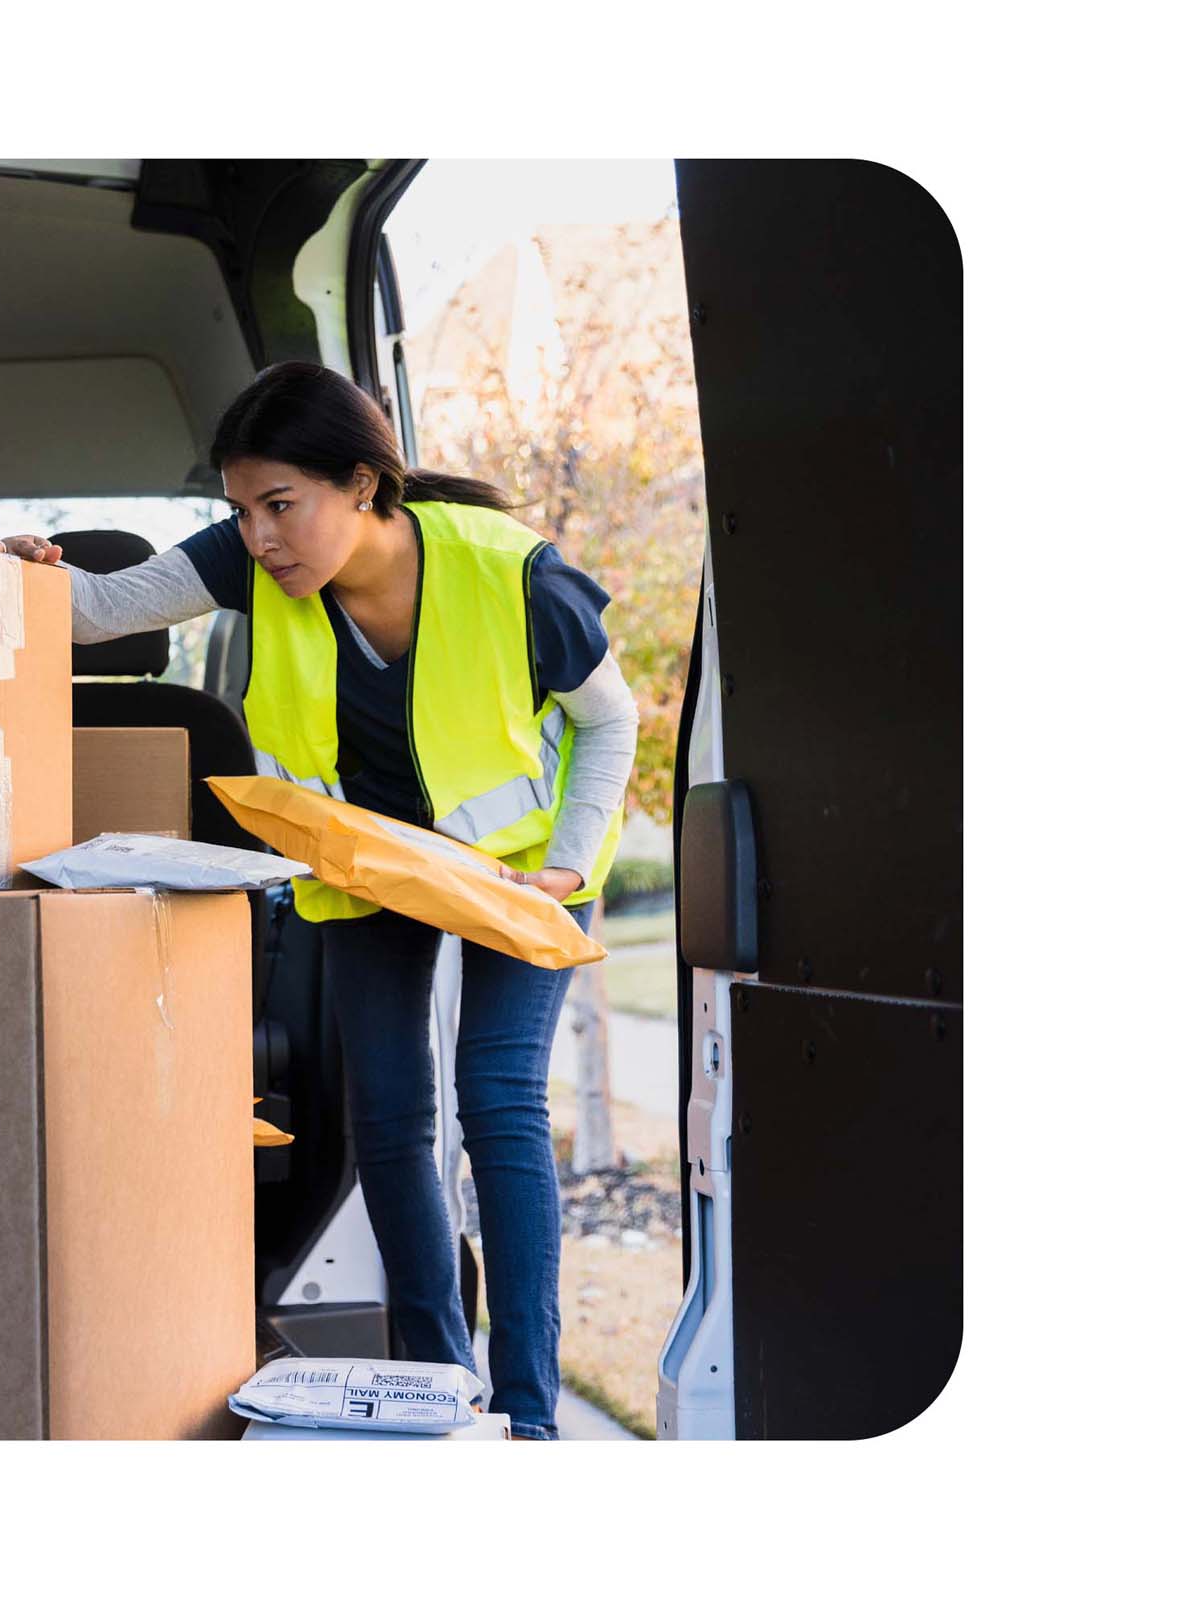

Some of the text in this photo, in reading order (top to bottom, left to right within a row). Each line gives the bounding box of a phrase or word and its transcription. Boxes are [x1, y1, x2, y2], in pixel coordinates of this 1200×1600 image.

[347, 1389, 456, 1402] ECONOMY MAIL
[348, 1401, 374, 1417] E
